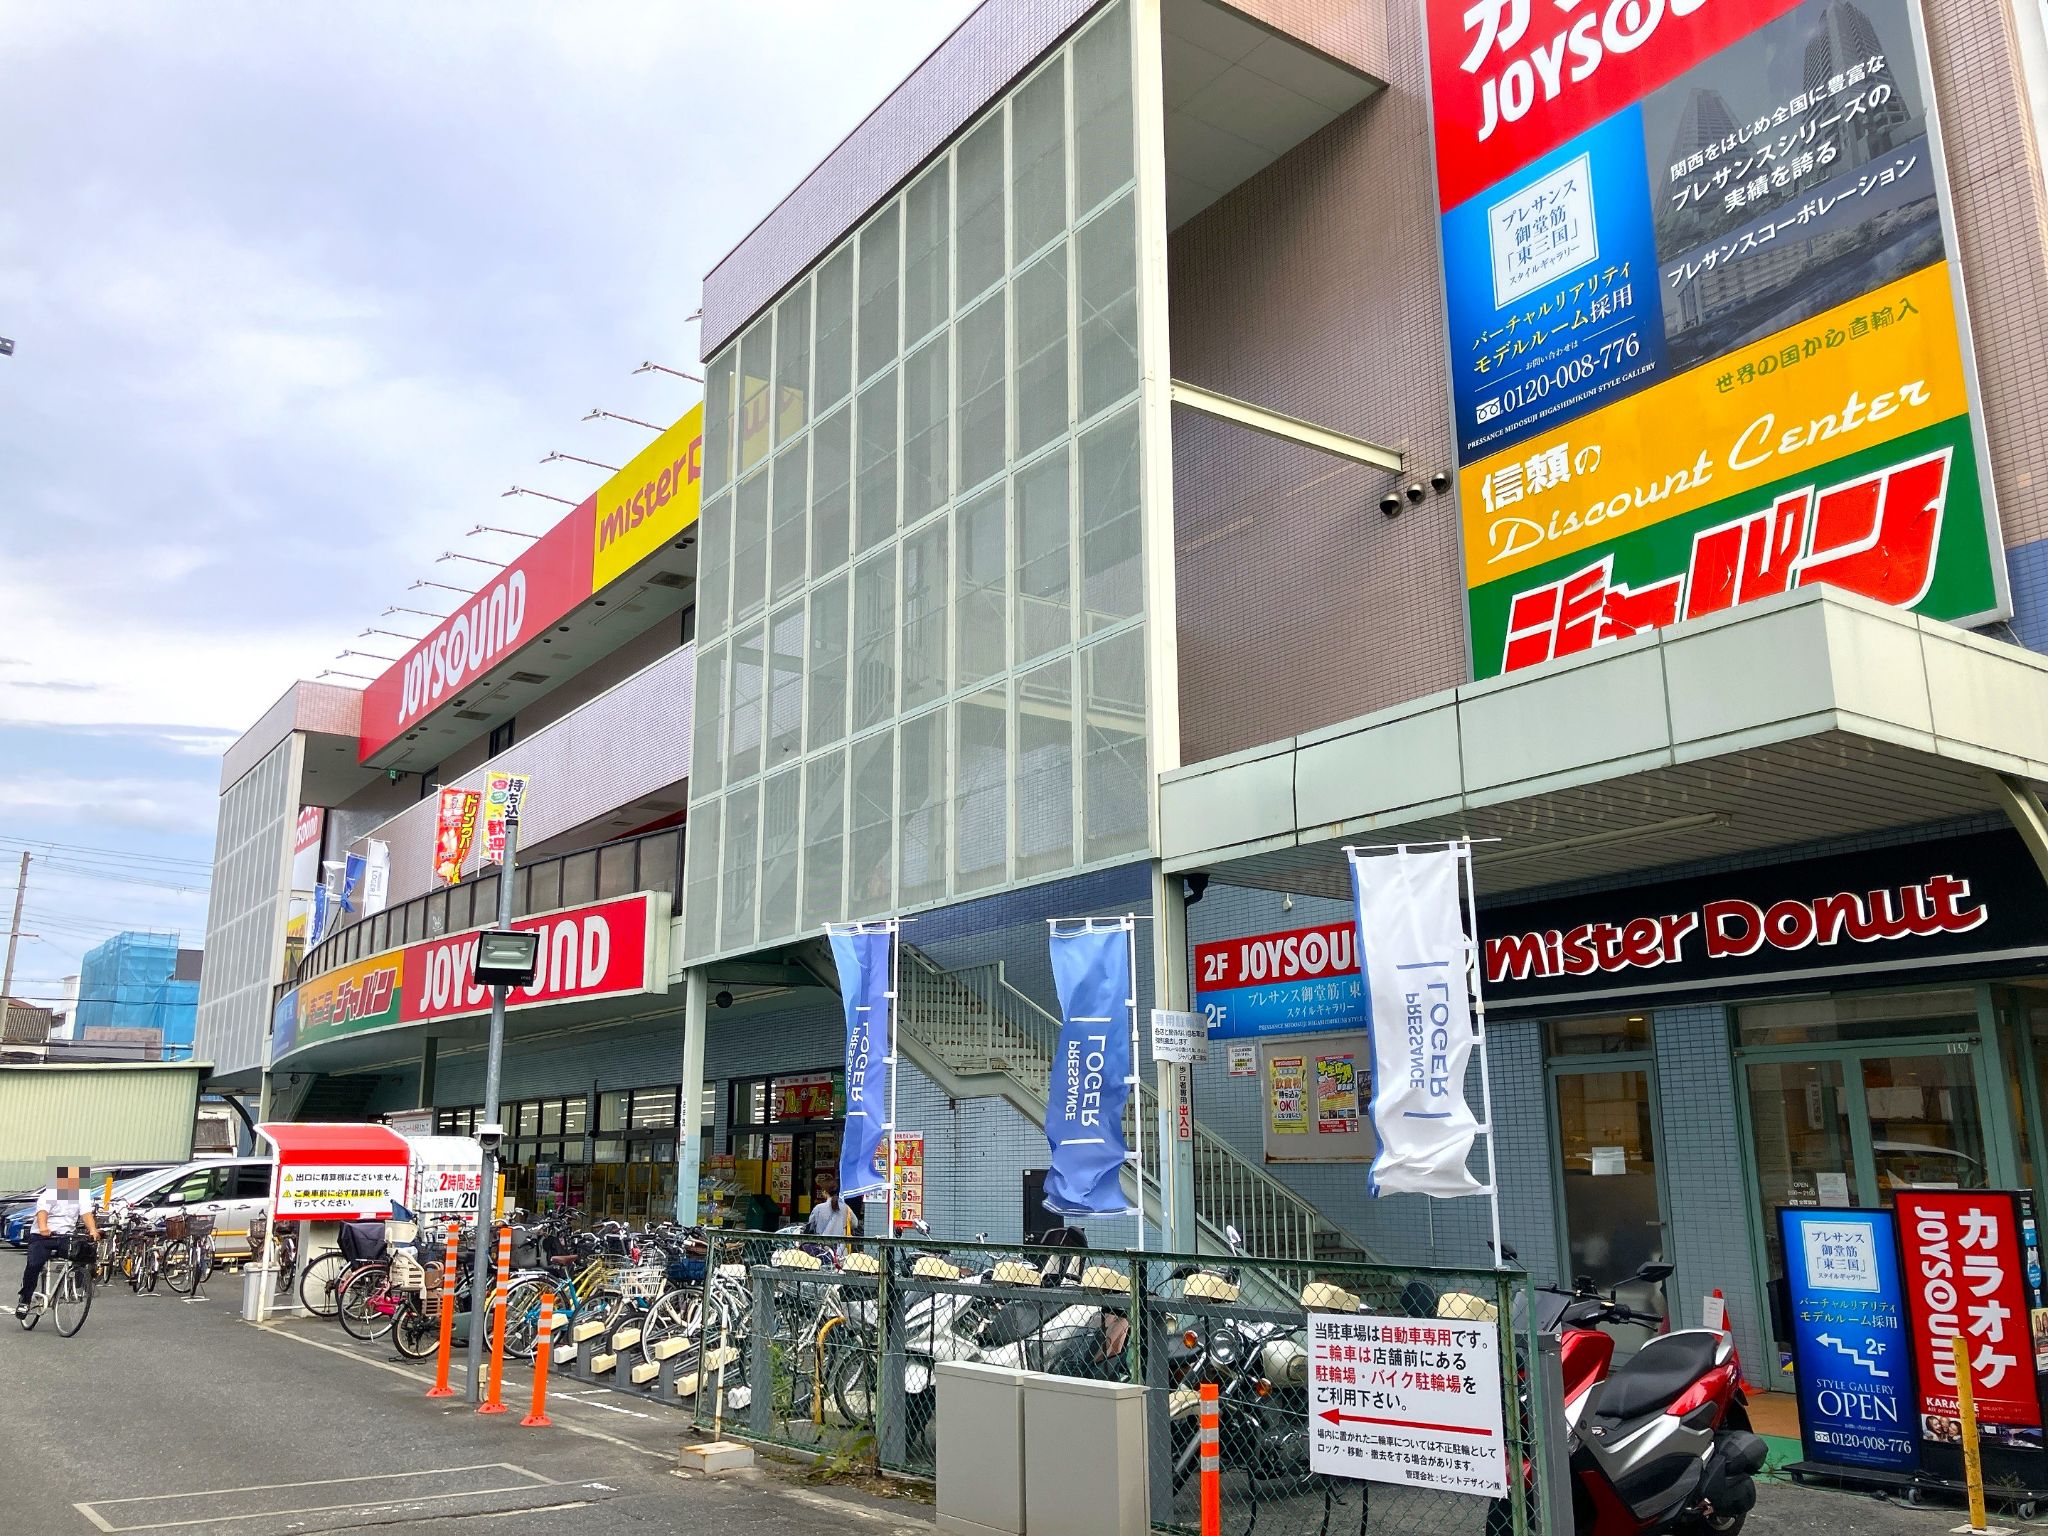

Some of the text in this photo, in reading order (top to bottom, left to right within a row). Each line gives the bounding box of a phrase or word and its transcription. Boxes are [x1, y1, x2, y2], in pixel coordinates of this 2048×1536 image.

[1670, 55, 1886, 183] 関西をはじめ全国に豊富な
[1672, 84, 1892, 212] プレサンスシリーズの
[1724, 140, 1837, 214] 実績を誇る
[1502, 179, 1578, 231] プレサンス
[1515, 204, 1567, 247] 御堂筋
[1667, 155, 1918, 288] プレサンスコーポレーション
[1507, 217, 1579, 273] 「東三国」
[1509, 244, 1581, 286] スタイルギャラリー
[1472, 261, 1631, 351] バーチャルリアリティ
[1473, 283, 1633, 374] モデルルーム採用
[1525, 340, 1579, 371] お問い合わせは
[1715, 297, 1919, 394] 世界の国から直輸入
[1503, 332, 1640, 413] 0120-008-776
[1467, 428, 1504, 450] PRESSANCE
[1504, 414, 1539, 433] MIDOSUJI
[1539, 388, 1598, 419] HIGASHIMIKUNI
[1598, 377, 1622, 394] STYLE
[1621, 361, 1657, 384] GALLERY
[1481, 441, 1602, 514] 信頼の
[1487, 380, 1931, 565] Discount Center
[398, 569, 527, 726] JOYSOUND
[419, 914, 611, 1014] JOYSUND
[1204, 952, 1229, 982] 2F
[331, 966, 398, 1026] ジャパン
[1204, 979, 1366, 1029] 2F プレサンス御堂筋「東
[1286, 1003, 1355, 1019] スタイルギャラリー
[294, 1188, 390, 1198] ご乗車前に必ず精算操作を
[295, 1173, 403, 1182] 出口に精算機はございません。
[294, 1199, 354, 1208] 行ってください。
[1811, 1231, 1865, 1243] プレサンス
[1821, 1244, 1858, 1257] 御堂筋
[1816, 1257, 1866, 1272] 「東三国」
[1818, 1272, 1868, 1281] スタイルギャラリー
[1799, 1297, 1896, 1314] バーチャルリアリティ
[1957, 1207, 2018, 1389] カラオケ
[1799, 1310, 1898, 1329] モデルルーム採用
[1315, 1322, 1488, 1349] 当駐車場は自動車専用です。
[1865, 1338, 1887, 1356] 2F
[1315, 1344, 1467, 1371] 二輪車は店舗前にある
[1315, 1365, 1477, 1395] 駐輪場・バイク駐輪場を
[1816, 1379, 1895, 1395] STYLE GALLERY
[1317, 1387, 1407, 1411] ご利用下さい。
[1817, 1390, 1898, 1422] OPEN
[1317, 1428, 1497, 1459] 場内に置かれた二輪車については不正駐輪として
[1317, 1444, 1475, 1472] ロック・移動・撤去をする場合があります。
[1831, 1432, 1912, 1454] 0120-008-776
